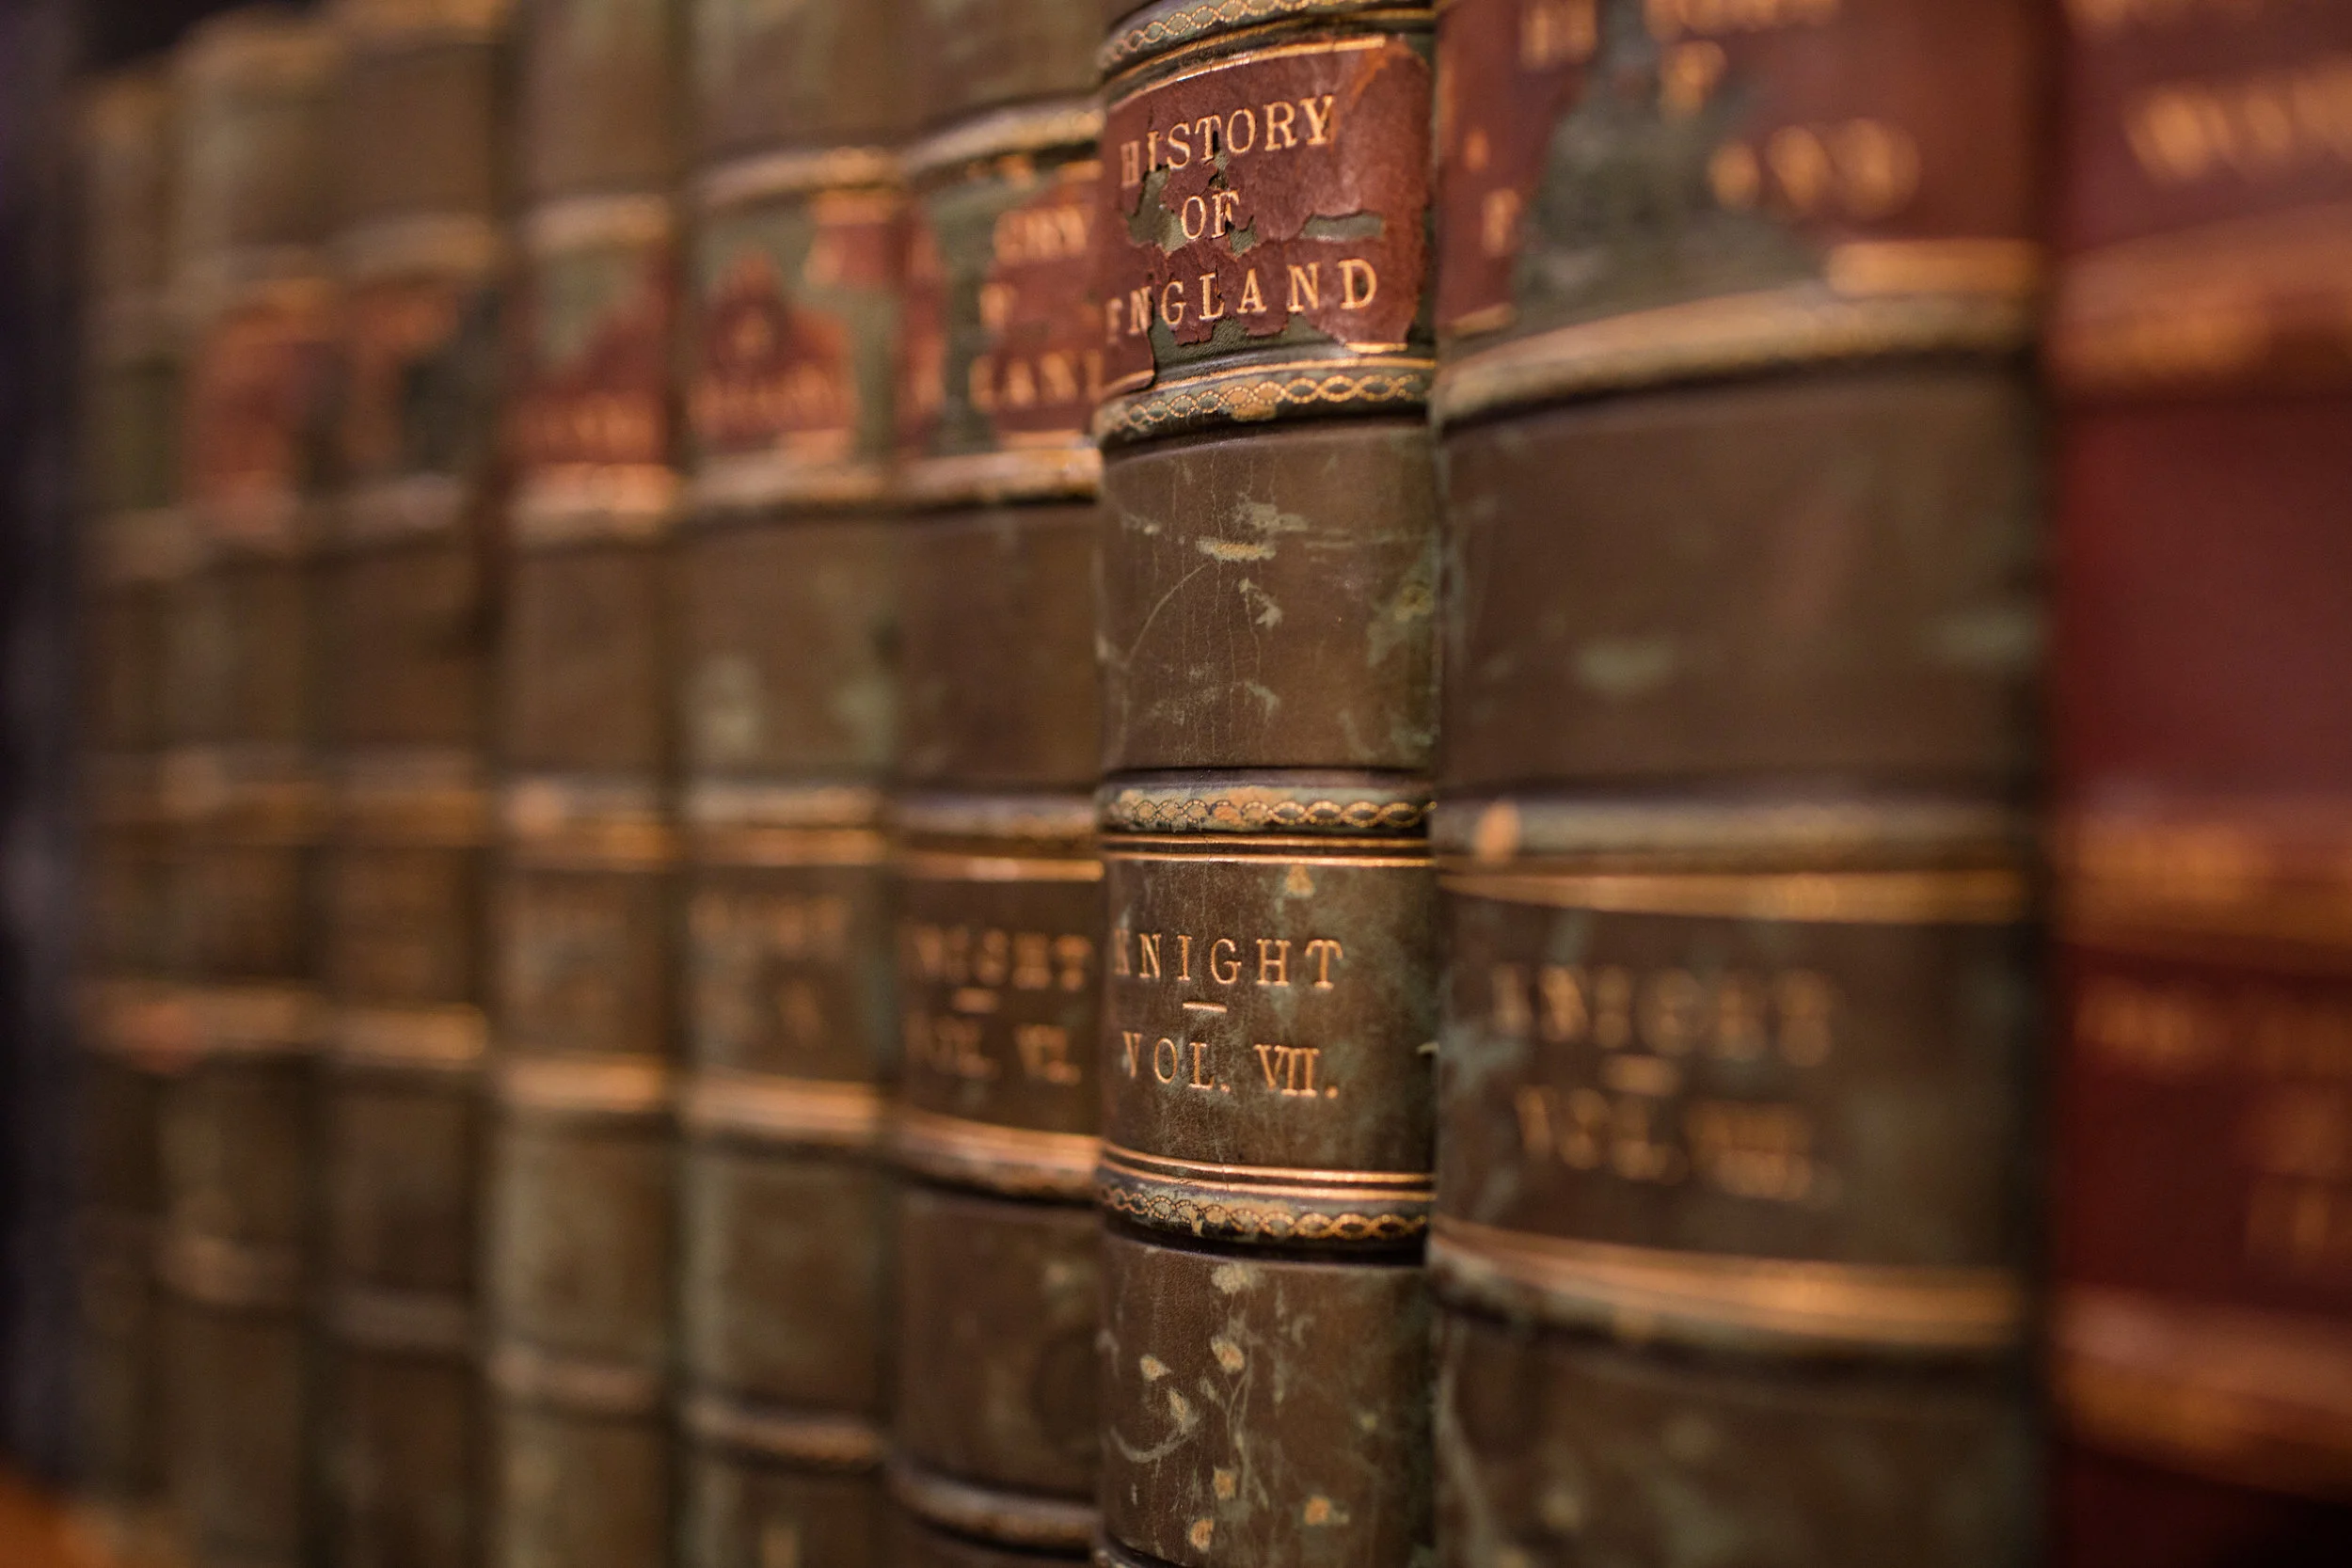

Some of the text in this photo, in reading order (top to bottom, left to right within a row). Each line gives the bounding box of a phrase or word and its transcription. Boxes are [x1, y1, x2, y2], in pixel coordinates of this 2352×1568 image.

[1119, 94, 1335, 188] HISTORY
[1180, 190, 1240, 240] OF
[1112, 927, 1343, 990] KNIGHT
[1122, 1031, 1340, 1100] VOL. VII.
